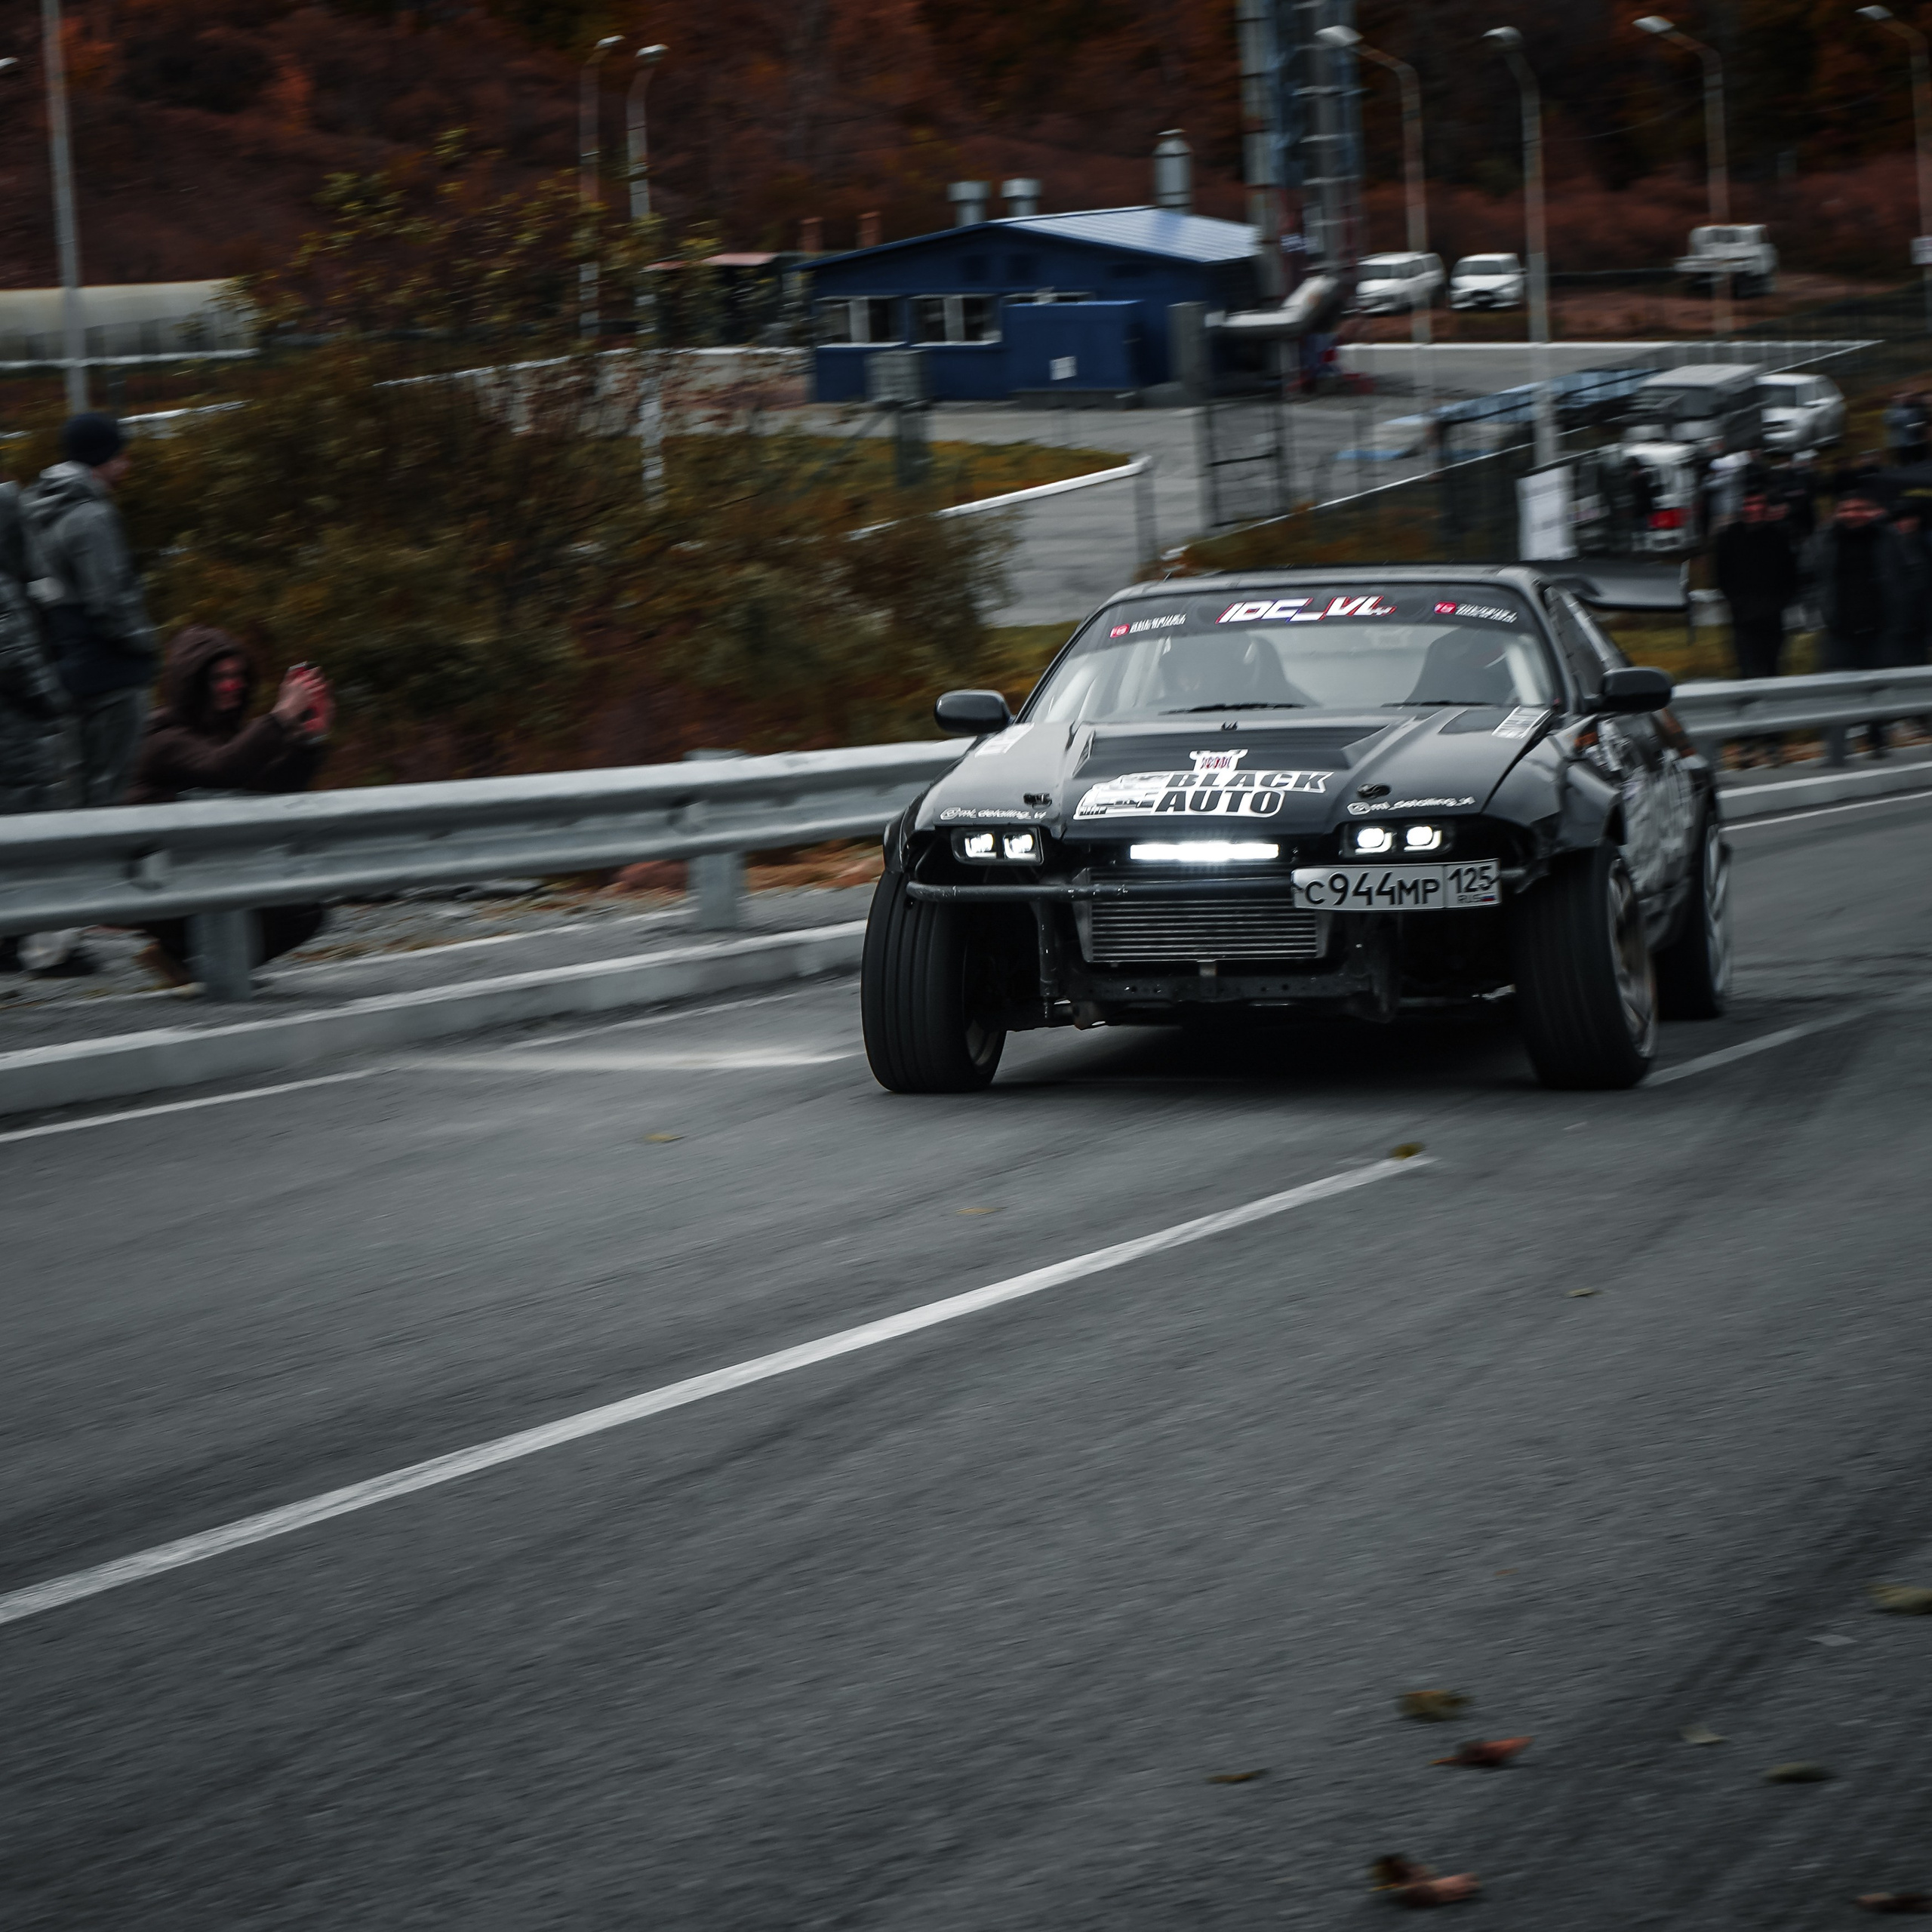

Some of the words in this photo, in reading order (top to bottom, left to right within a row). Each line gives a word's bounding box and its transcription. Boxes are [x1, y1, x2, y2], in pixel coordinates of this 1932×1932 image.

[1164, 772, 1331, 791] BLACK
[1155, 790, 1281, 814] AUTO
[1447, 864, 1492, 894] 125
